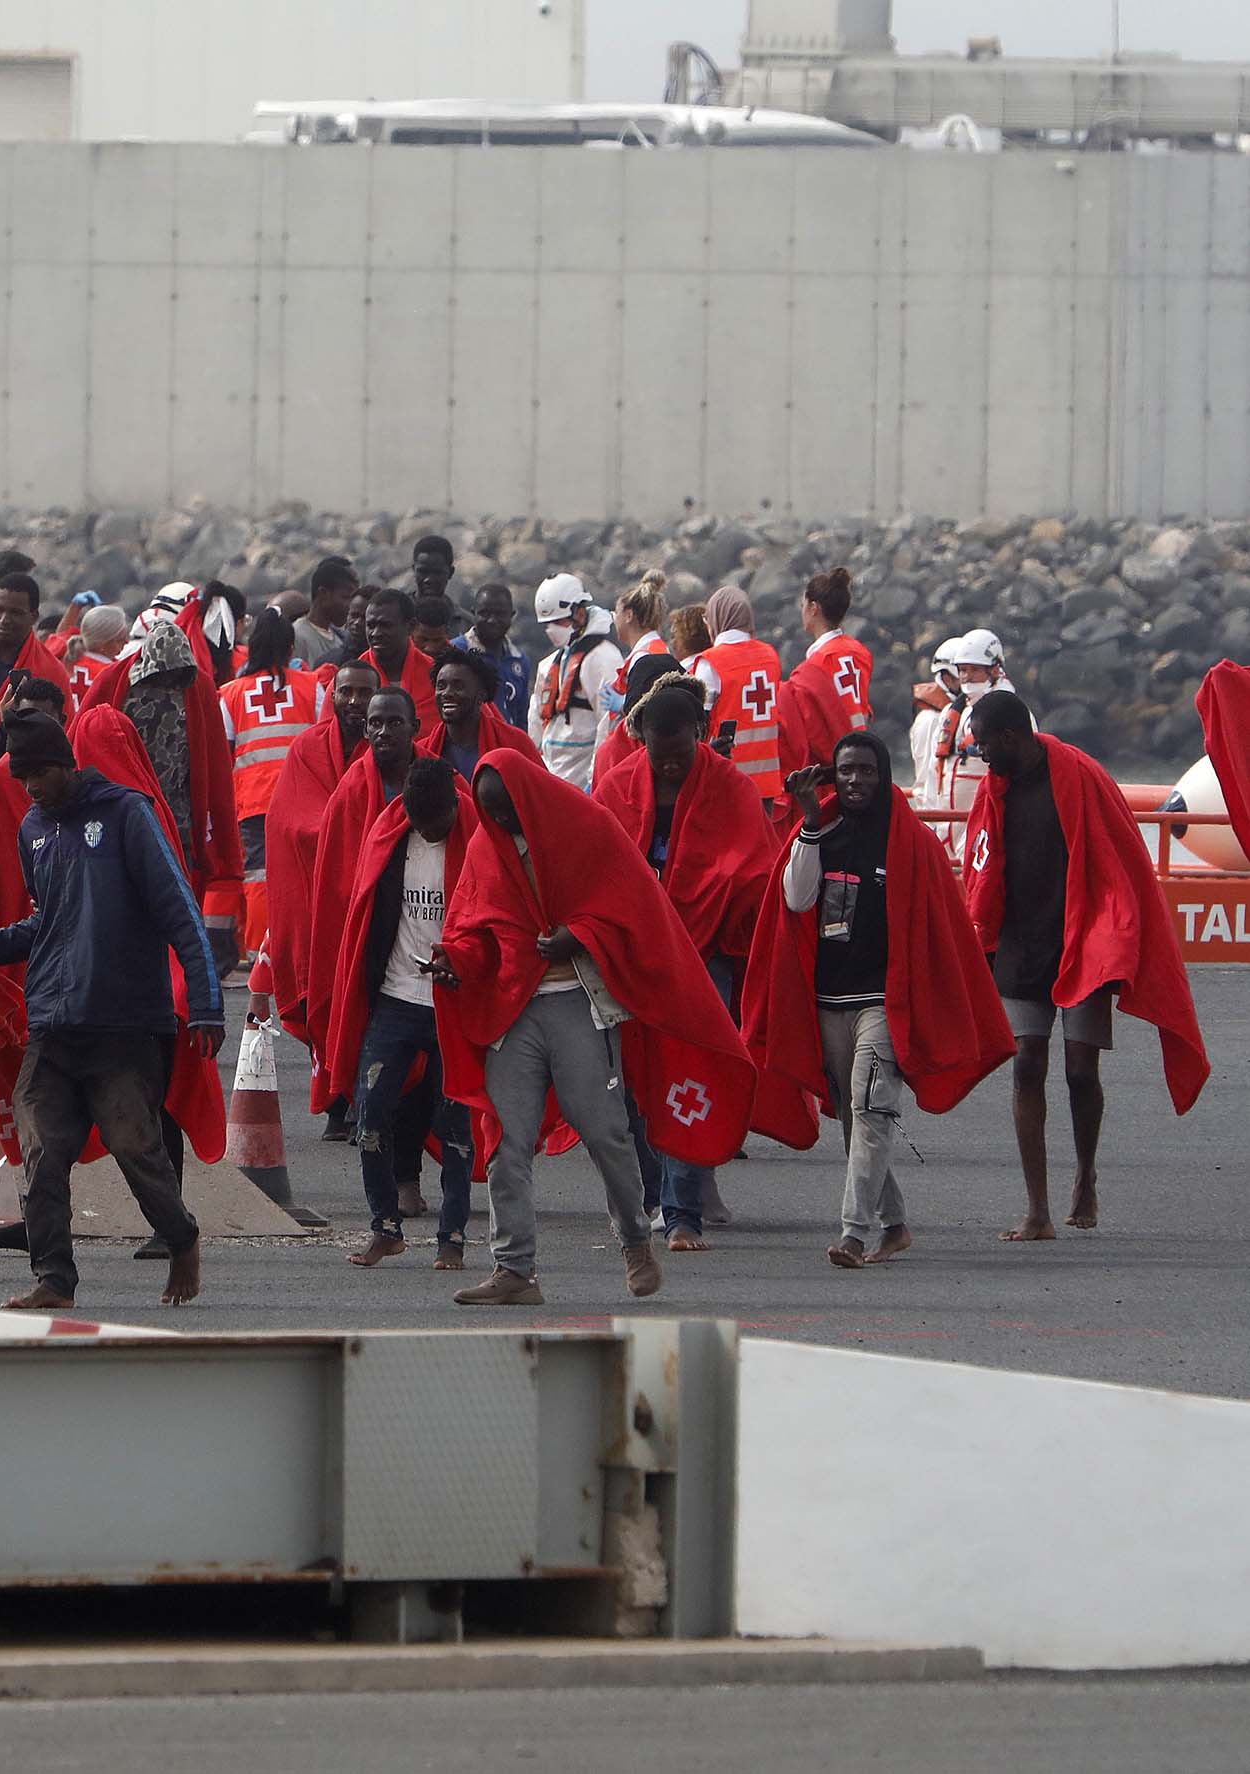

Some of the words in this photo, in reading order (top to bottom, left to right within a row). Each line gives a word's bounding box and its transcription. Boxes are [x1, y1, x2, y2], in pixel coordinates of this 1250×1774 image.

[404, 885, 444, 905] mira
[422, 907, 445, 921] BETT
[1177, 903, 1250, 943] TAL
